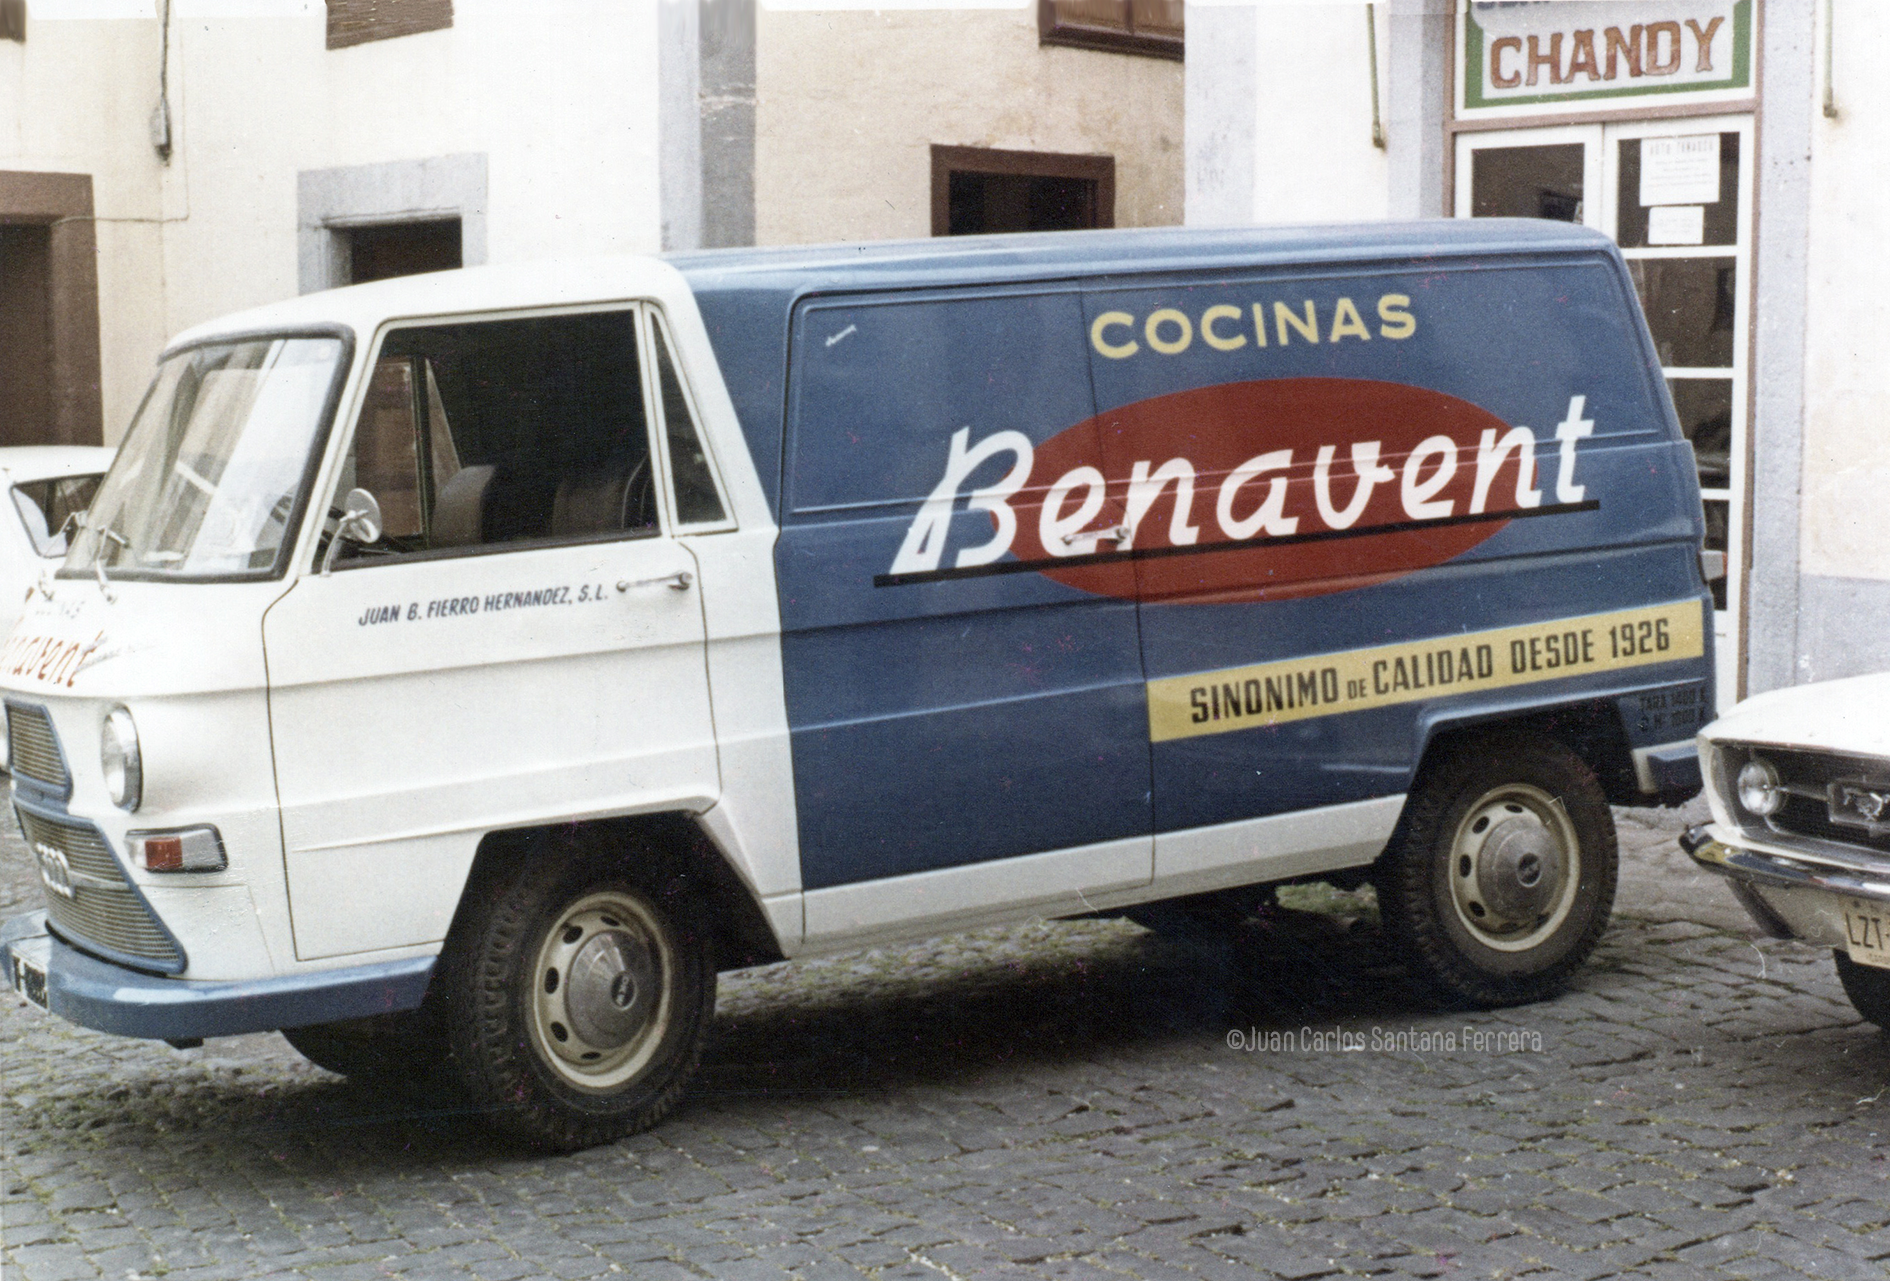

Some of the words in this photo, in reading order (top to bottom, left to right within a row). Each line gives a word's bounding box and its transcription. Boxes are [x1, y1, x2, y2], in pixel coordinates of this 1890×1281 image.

[1490, 16, 1725, 89] CHANDY
[1090, 294, 1417, 359] COCINAS
[888, 395, 1594, 575] Benavent
[358, 605, 400, 627] JUAN
[407, 602, 422, 621] B.
[427, 597, 480, 618] FIERRO
[484, 586, 573, 612] HERNANDEZ,
[1190, 667, 1339, 724] SINONIMO
[1346, 677, 1368, 700] DE
[1373, 644, 1493, 694] CALIDAD
[1510, 629, 1595, 674] DESDE
[1609, 618, 1670, 658] 1926
